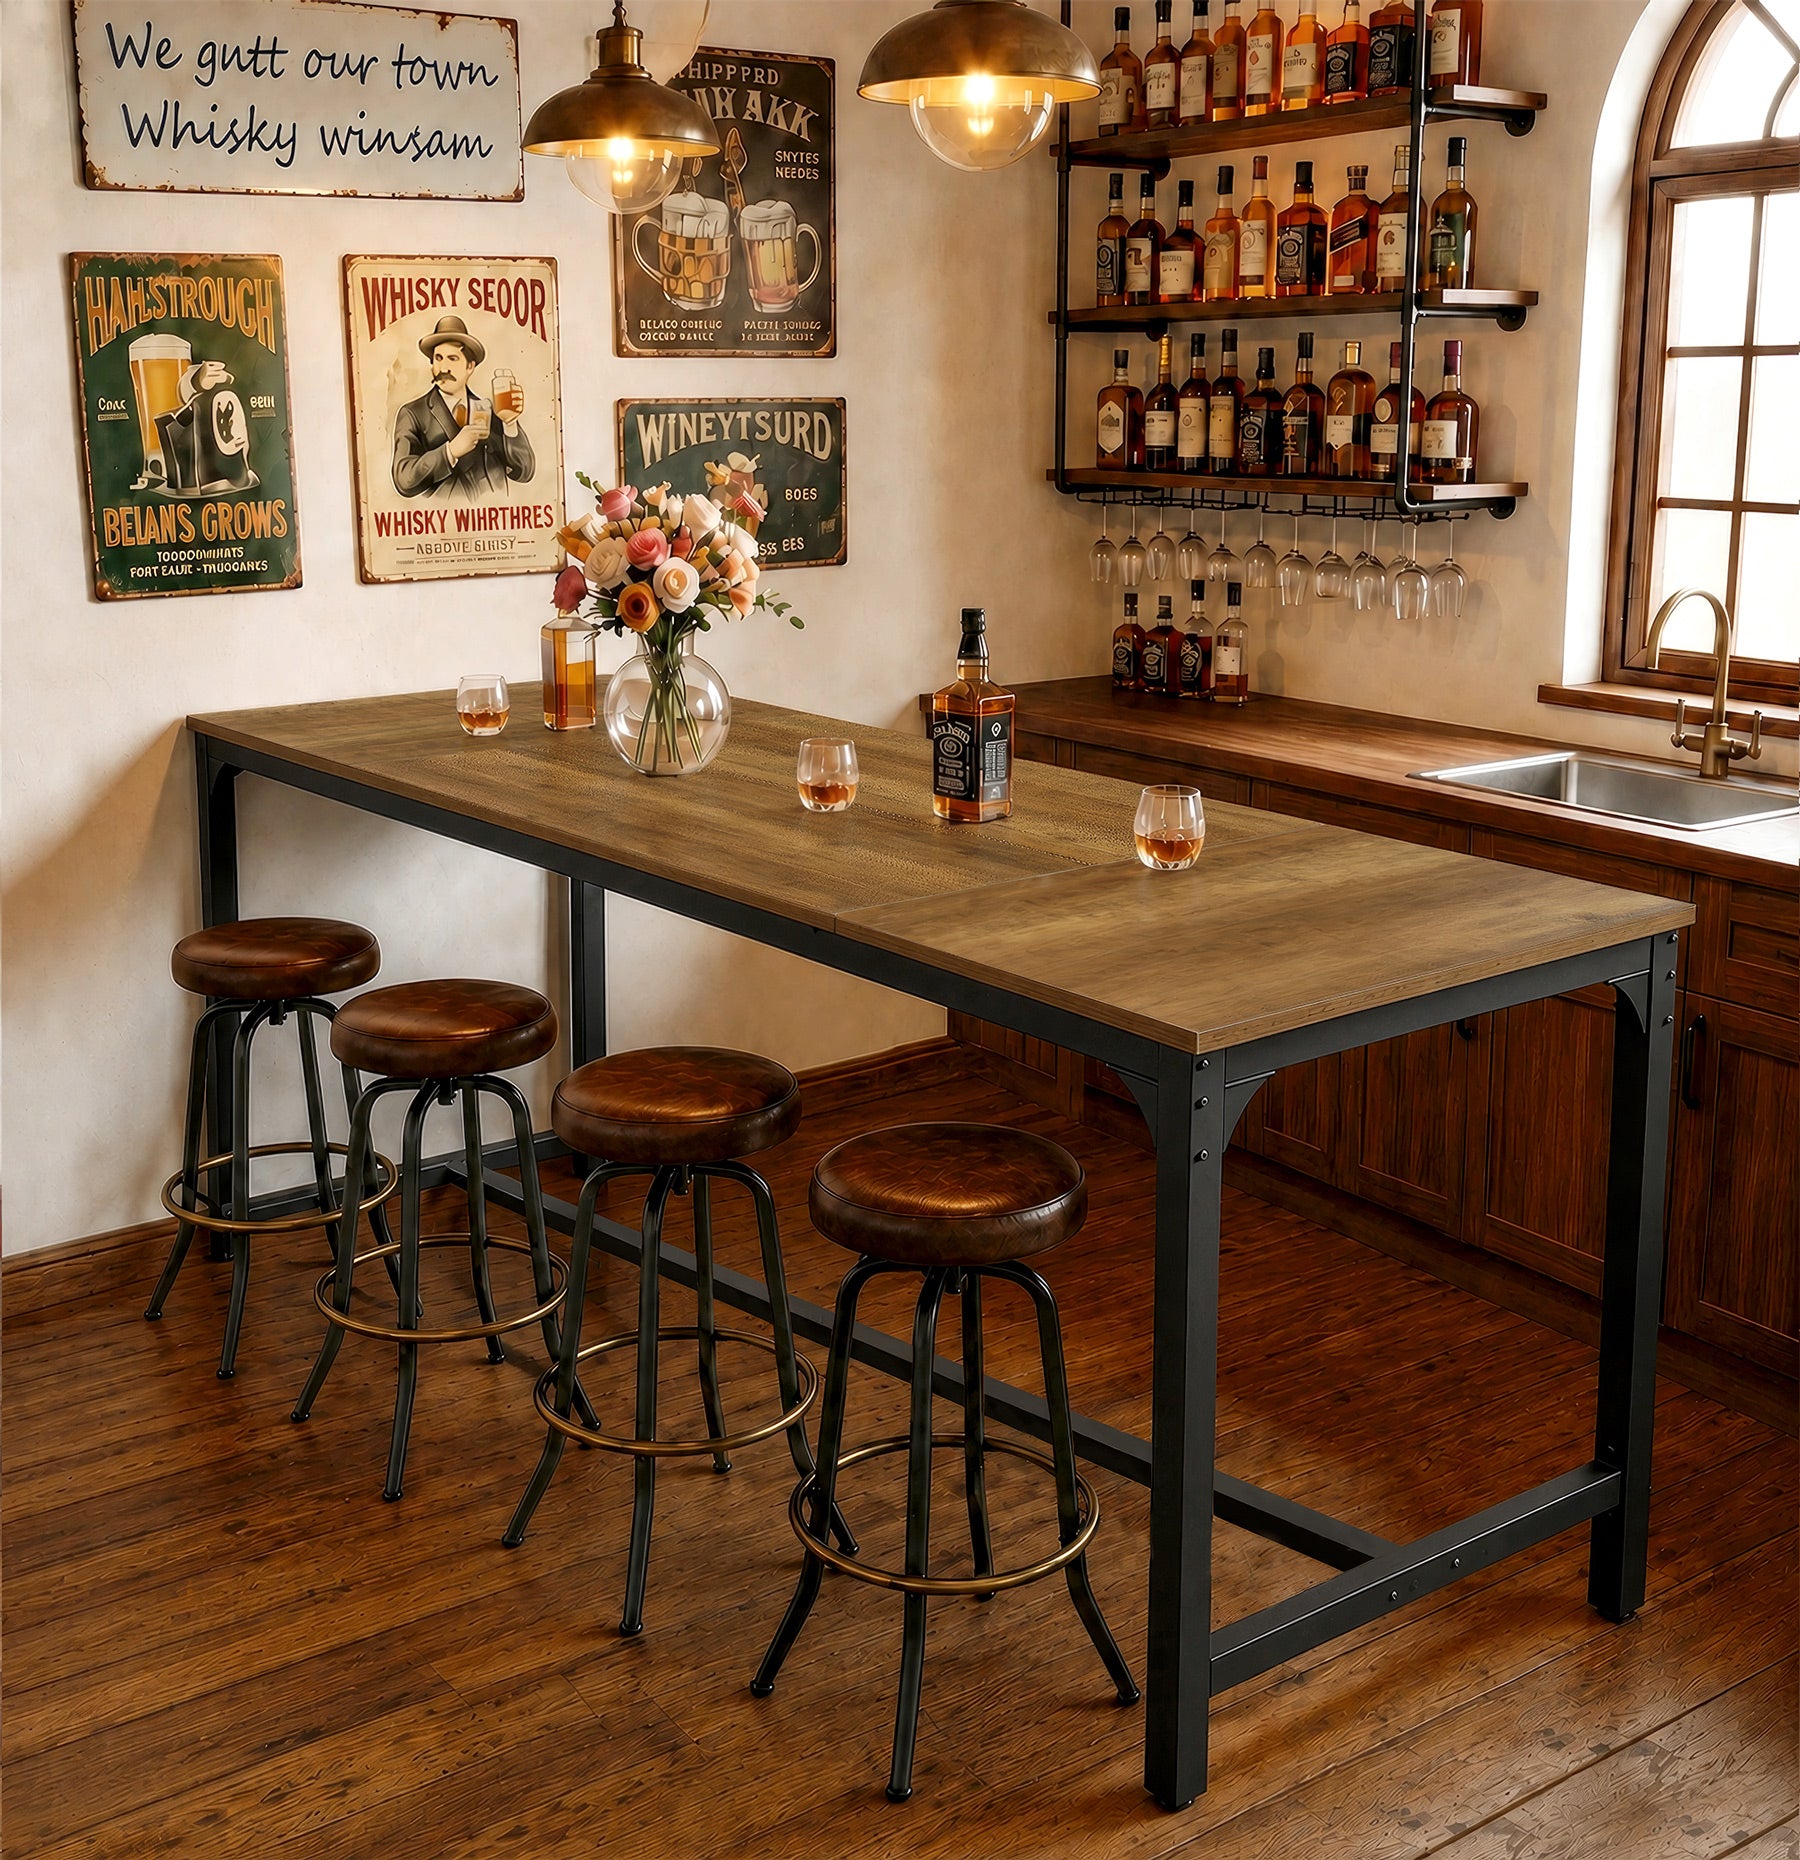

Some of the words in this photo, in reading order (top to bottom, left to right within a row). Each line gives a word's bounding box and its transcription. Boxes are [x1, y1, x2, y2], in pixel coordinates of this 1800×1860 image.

[105, 21, 183, 70] We
[304, 48, 378, 85] our
[391, 42, 499, 91] town
[121, 99, 297, 167] Whisky
[361, 277, 461, 343] WHISKY
[103, 503, 196, 547] BELANS
[374, 509, 448, 538] WHISKY
